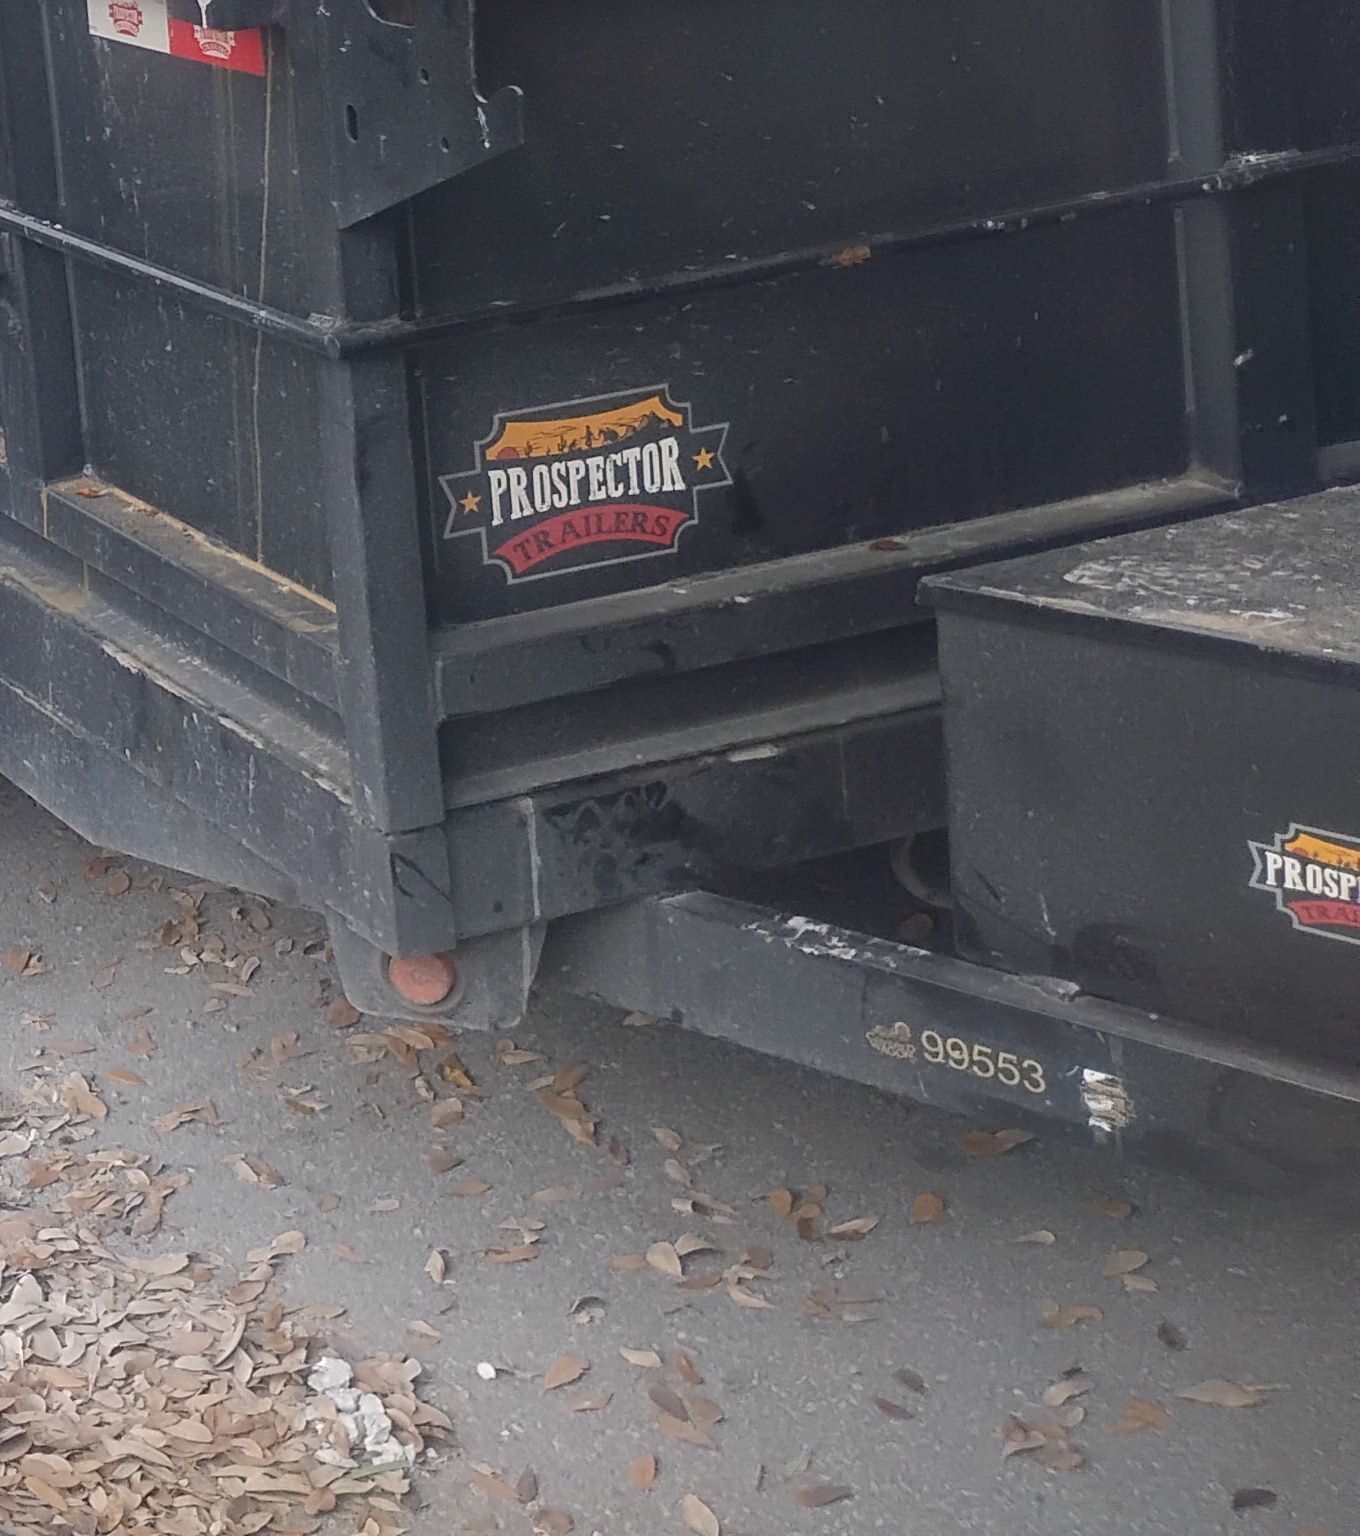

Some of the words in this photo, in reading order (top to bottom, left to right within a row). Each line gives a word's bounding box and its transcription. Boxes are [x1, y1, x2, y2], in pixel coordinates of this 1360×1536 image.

[487, 436, 686, 527] PROSPECTOR
[512, 511, 670, 564] TRAILERS
[1264, 851, 1360, 904] PROSP
[921, 1030, 1046, 1093] 99553
